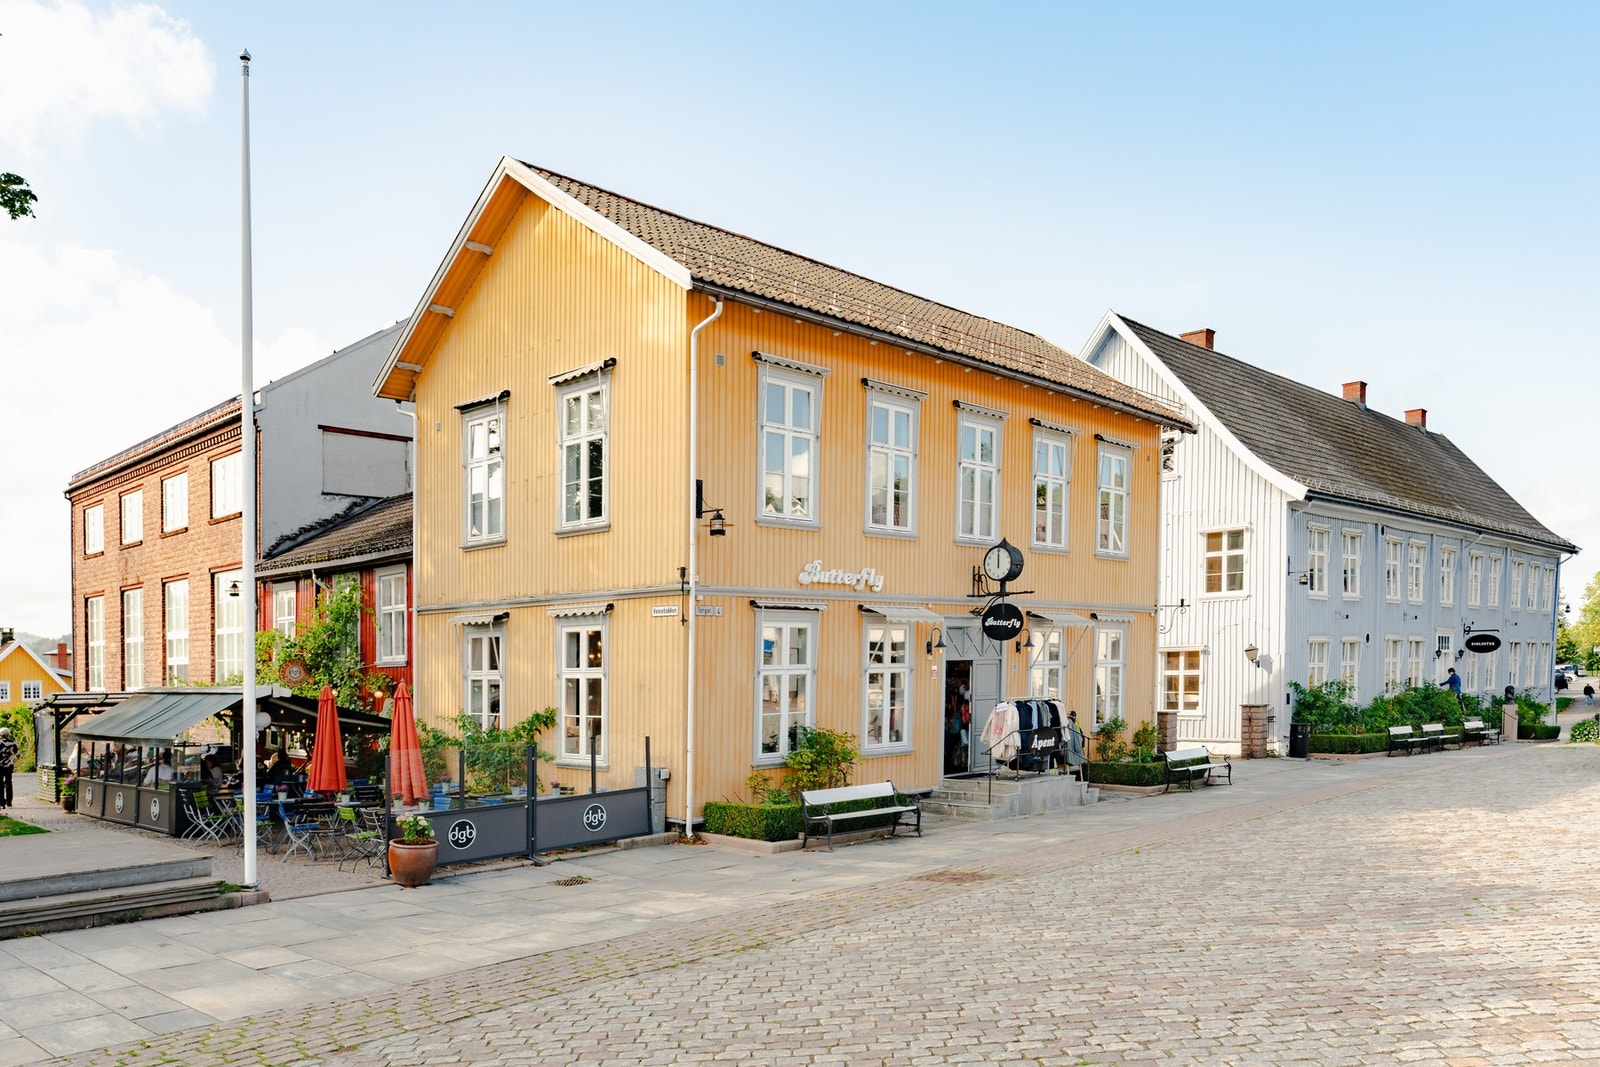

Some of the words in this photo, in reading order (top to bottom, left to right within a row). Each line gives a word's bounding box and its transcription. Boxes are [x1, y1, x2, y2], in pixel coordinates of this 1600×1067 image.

[798, 560, 883, 592] Butterfly
[985, 617, 1021, 628] Butterfly
[1031, 734, 1056, 750] Åpent
[584, 810, 606, 825] dgb
[450, 825, 475, 843] dgb
